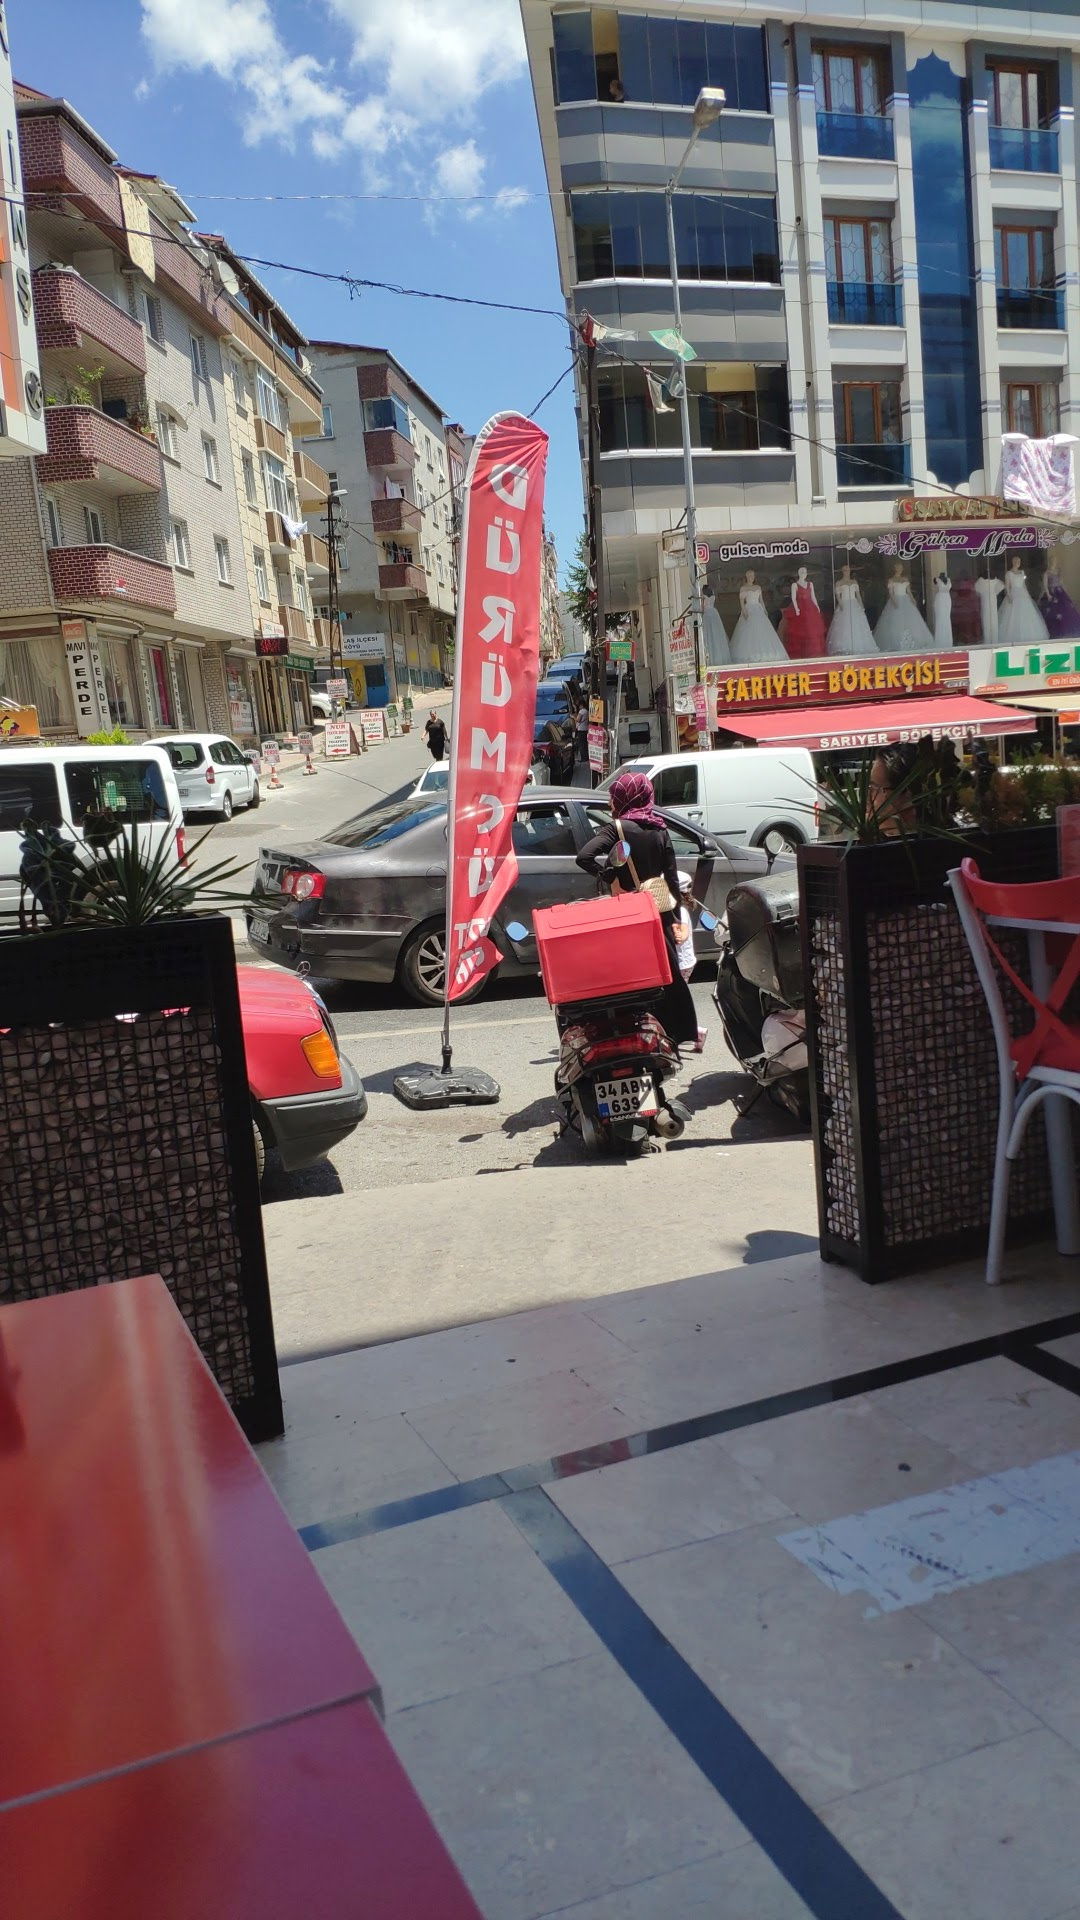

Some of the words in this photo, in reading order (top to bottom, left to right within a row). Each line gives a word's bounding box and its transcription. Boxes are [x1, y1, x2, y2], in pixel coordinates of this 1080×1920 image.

[720, 540, 810, 561] gulsen_moda
[899, 531, 968, 561] Gülşen
[966, 527, 1035, 557] Moda
[72, 654, 93, 716] PERDE
[93, 654, 108, 714] PERDE
[725, 672, 812, 702] SARIYER
[828, 658, 942, 693] BÖREKÇİSİ
[820, 732, 889, 748] SARIYER
[597, 1084, 618, 1099] 34
[620, 1079, 652, 1096] ABM
[611, 1096, 641, 1113] 639
